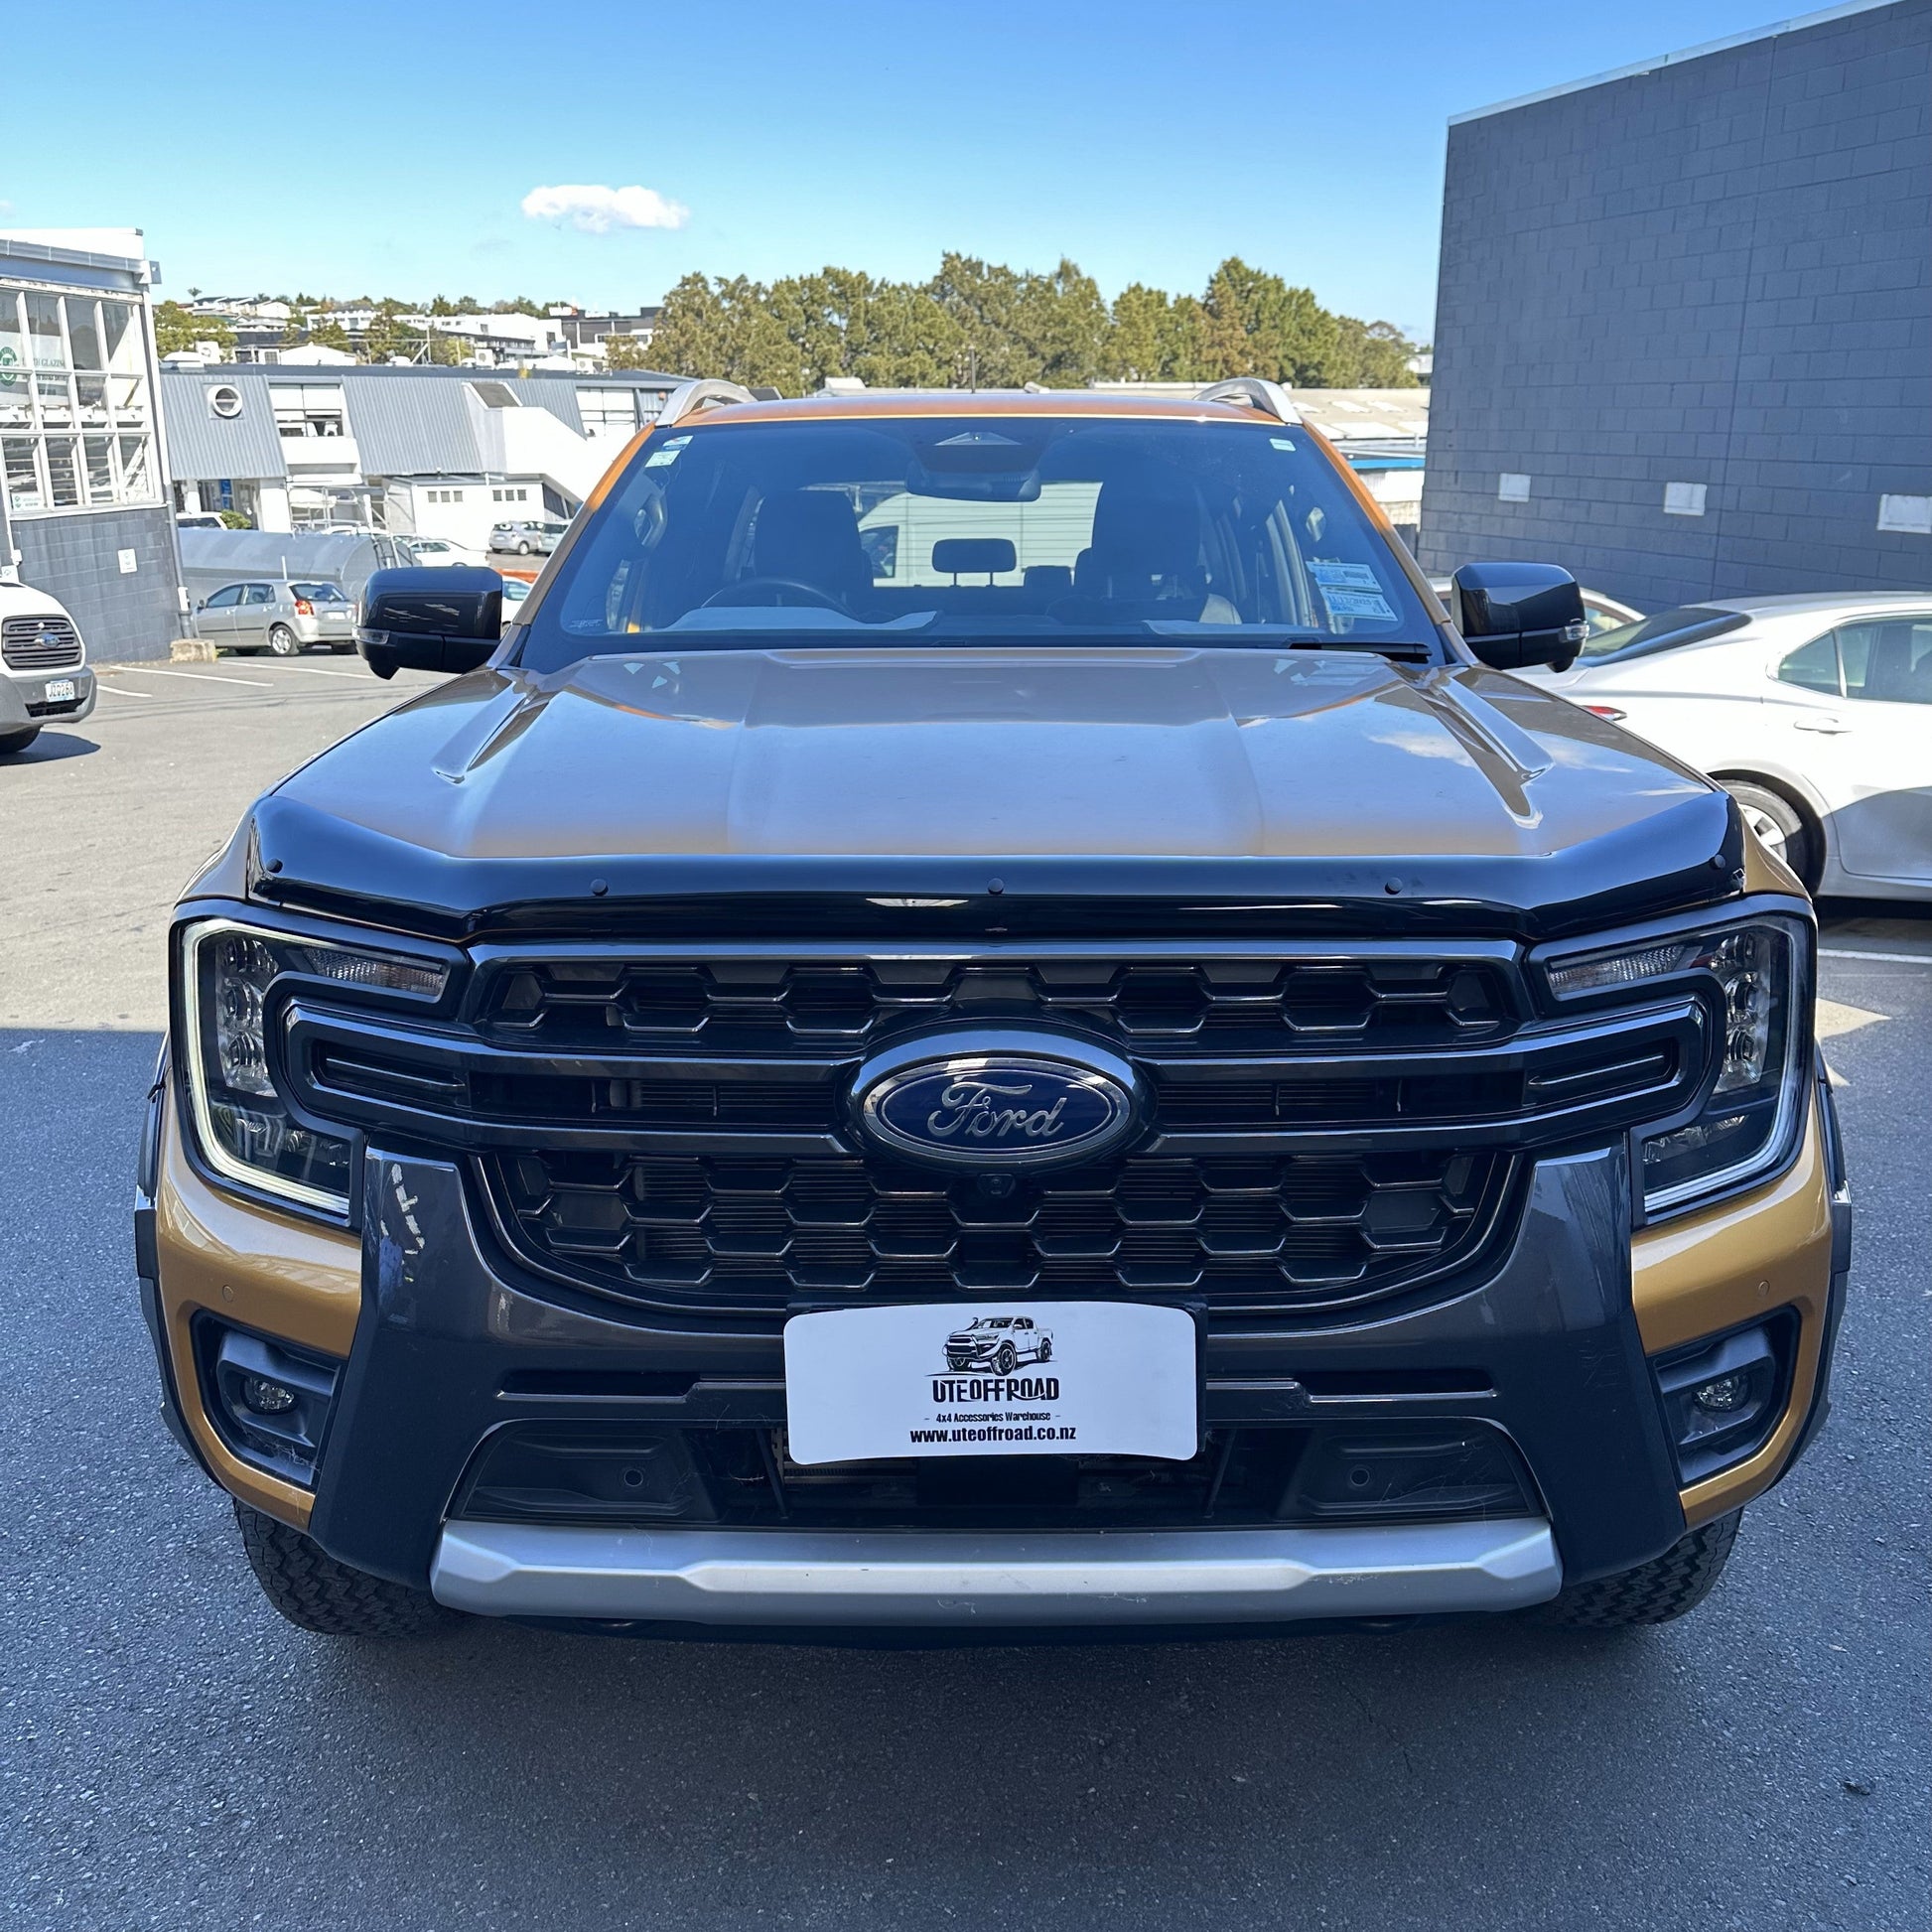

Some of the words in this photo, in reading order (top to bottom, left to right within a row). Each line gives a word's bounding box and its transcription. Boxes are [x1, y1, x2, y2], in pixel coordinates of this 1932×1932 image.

[927, 1081, 1068, 1137] Ford
[932, 1378, 1059, 1402] UTEOFFROAD
[936, 1413, 952, 1423] 4x4
[953, 1412, 1004, 1423] Accessories
[1005, 1411, 1051, 1422] Warehouse
[909, 1425, 1076, 1443] www.uteoffroad.co.nz
